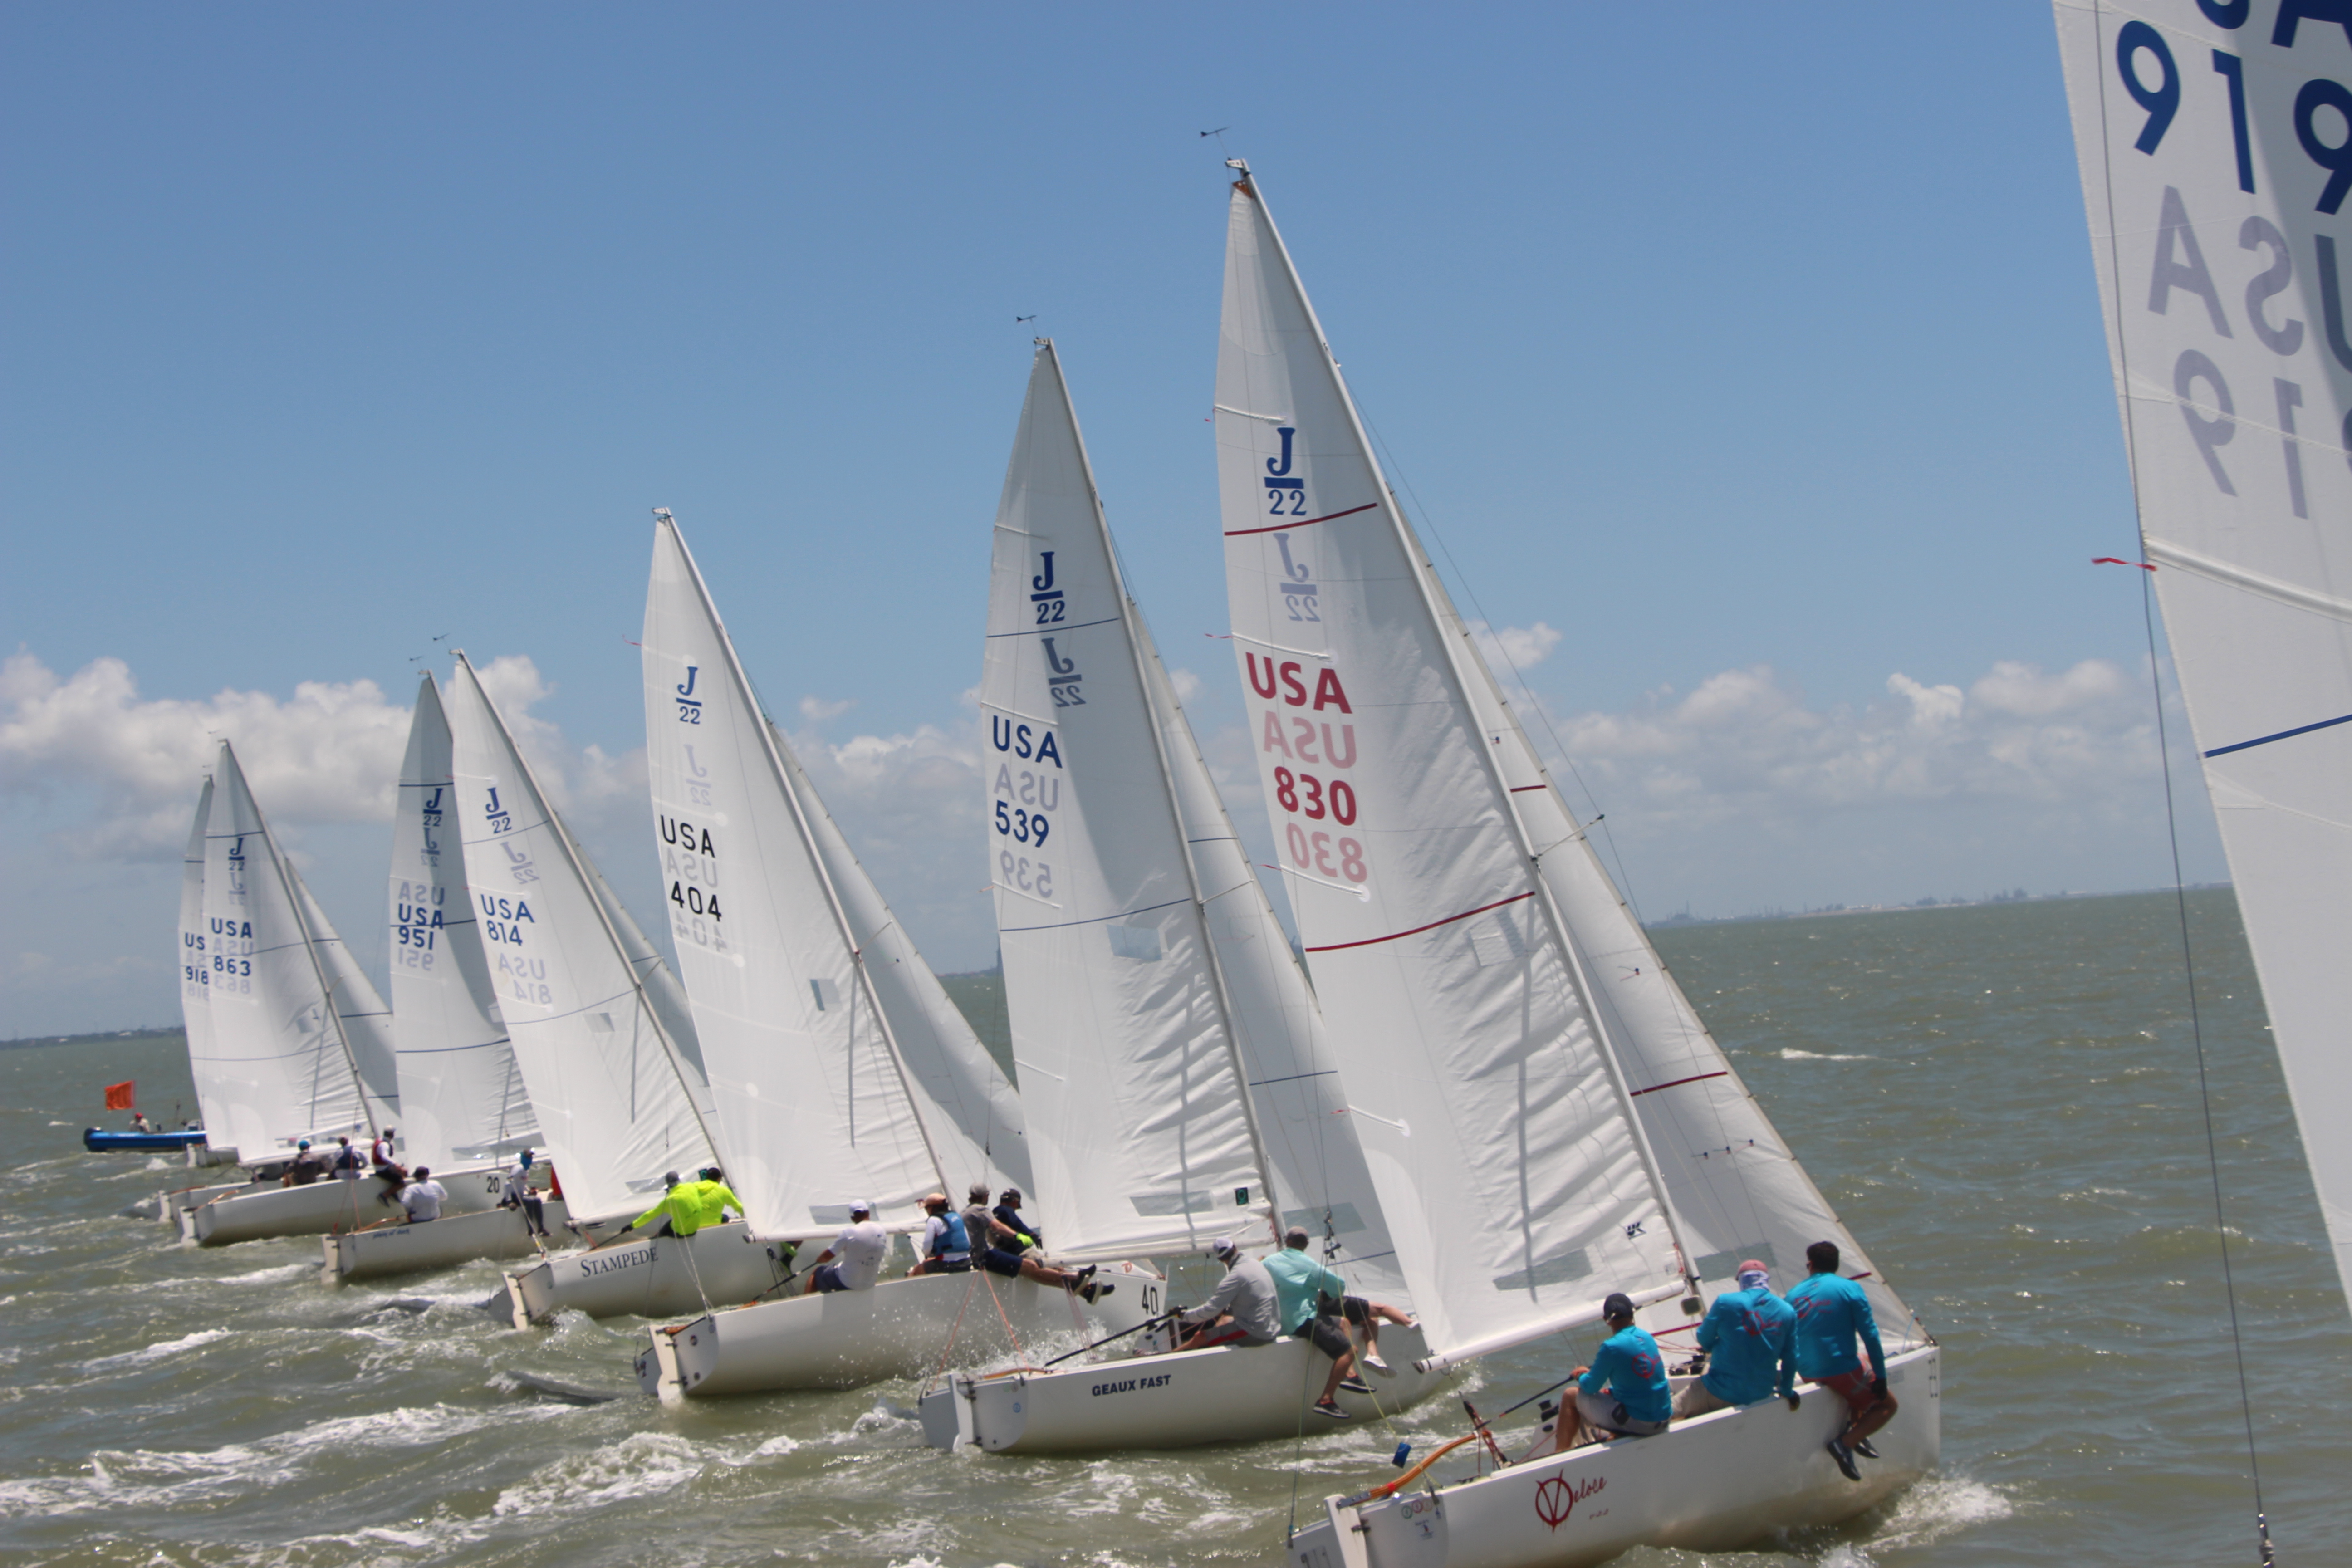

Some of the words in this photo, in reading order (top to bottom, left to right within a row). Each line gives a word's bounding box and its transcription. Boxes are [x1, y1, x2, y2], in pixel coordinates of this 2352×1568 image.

[2117, 20, 2352, 215] 919
[1266, 427, 1295, 476] J
[1269, 489, 1307, 515] 22
[1033, 551, 1054, 591] J
[1036, 600, 1065, 624] 22
[677, 666, 698, 696] J
[1245, 652, 1352, 714] USA
[679, 707, 700, 724] 22
[993, 715, 1063, 769] USA
[426, 788, 443, 809] J
[485, 787, 500, 813] J
[1274, 766, 1357, 826] 830
[423, 816, 441, 827] 22
[492, 817, 512, 834] 22
[995, 800, 1049, 848] 539
[230, 838, 244, 855] J
[661, 815, 715, 858] USA
[229, 862, 244, 871] 22
[480, 894, 534, 923] USA
[671, 881, 721, 921] 404
[211, 918, 252, 939] USA
[398, 903, 443, 930] USA
[185, 932, 205, 950] US
[399, 926, 434, 950] 951
[487, 920, 523, 946] 814
[186, 966, 208, 985] 918
[214, 956, 250, 976] 863
[487, 1176, 500, 1193] 20
[1142, 1284, 1158, 1315] 40
[1092, 1380, 1136, 1396] GEAUX
[1140, 1374, 1171, 1389] FAST
